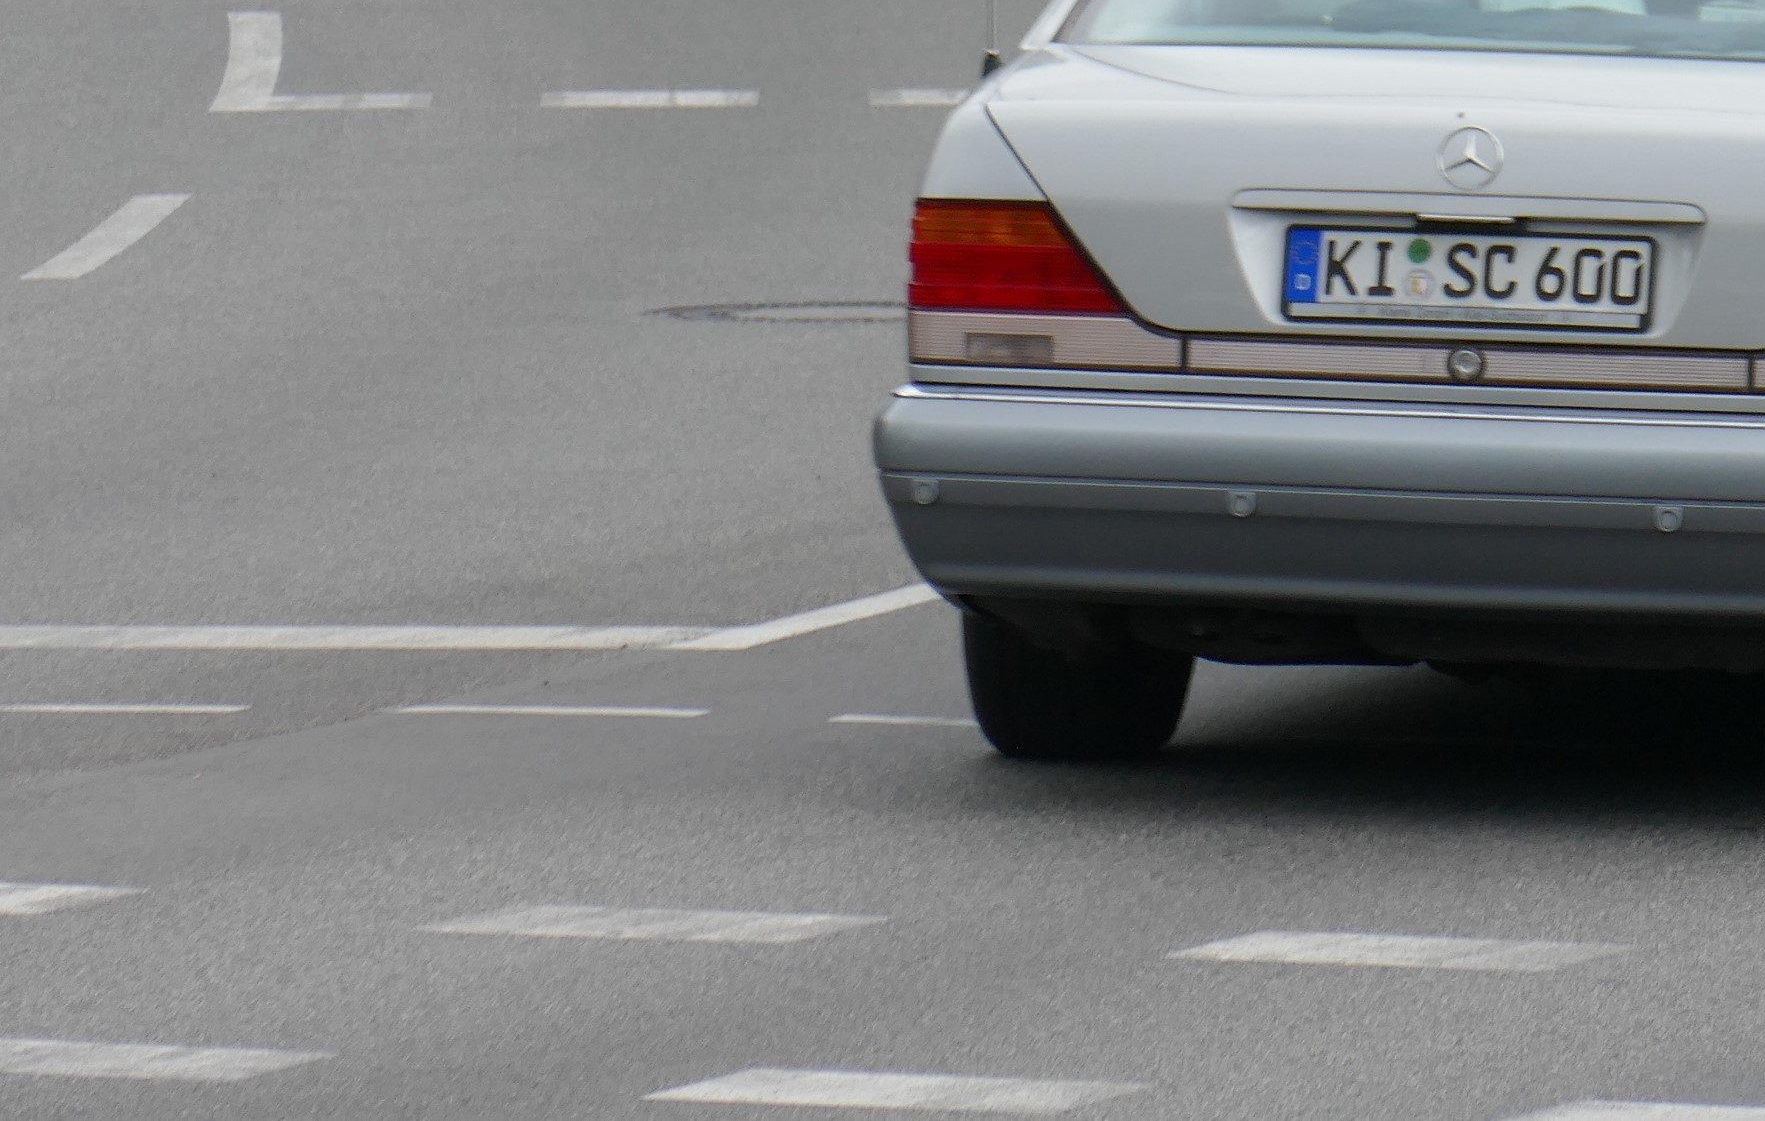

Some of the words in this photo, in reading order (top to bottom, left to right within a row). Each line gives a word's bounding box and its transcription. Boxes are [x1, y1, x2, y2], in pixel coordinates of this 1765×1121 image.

[1294, 273, 1312, 291] D
[1325, 239, 1395, 296] KI
[1443, 242, 1517, 300] SC
[1535, 246, 1642, 305] 600
